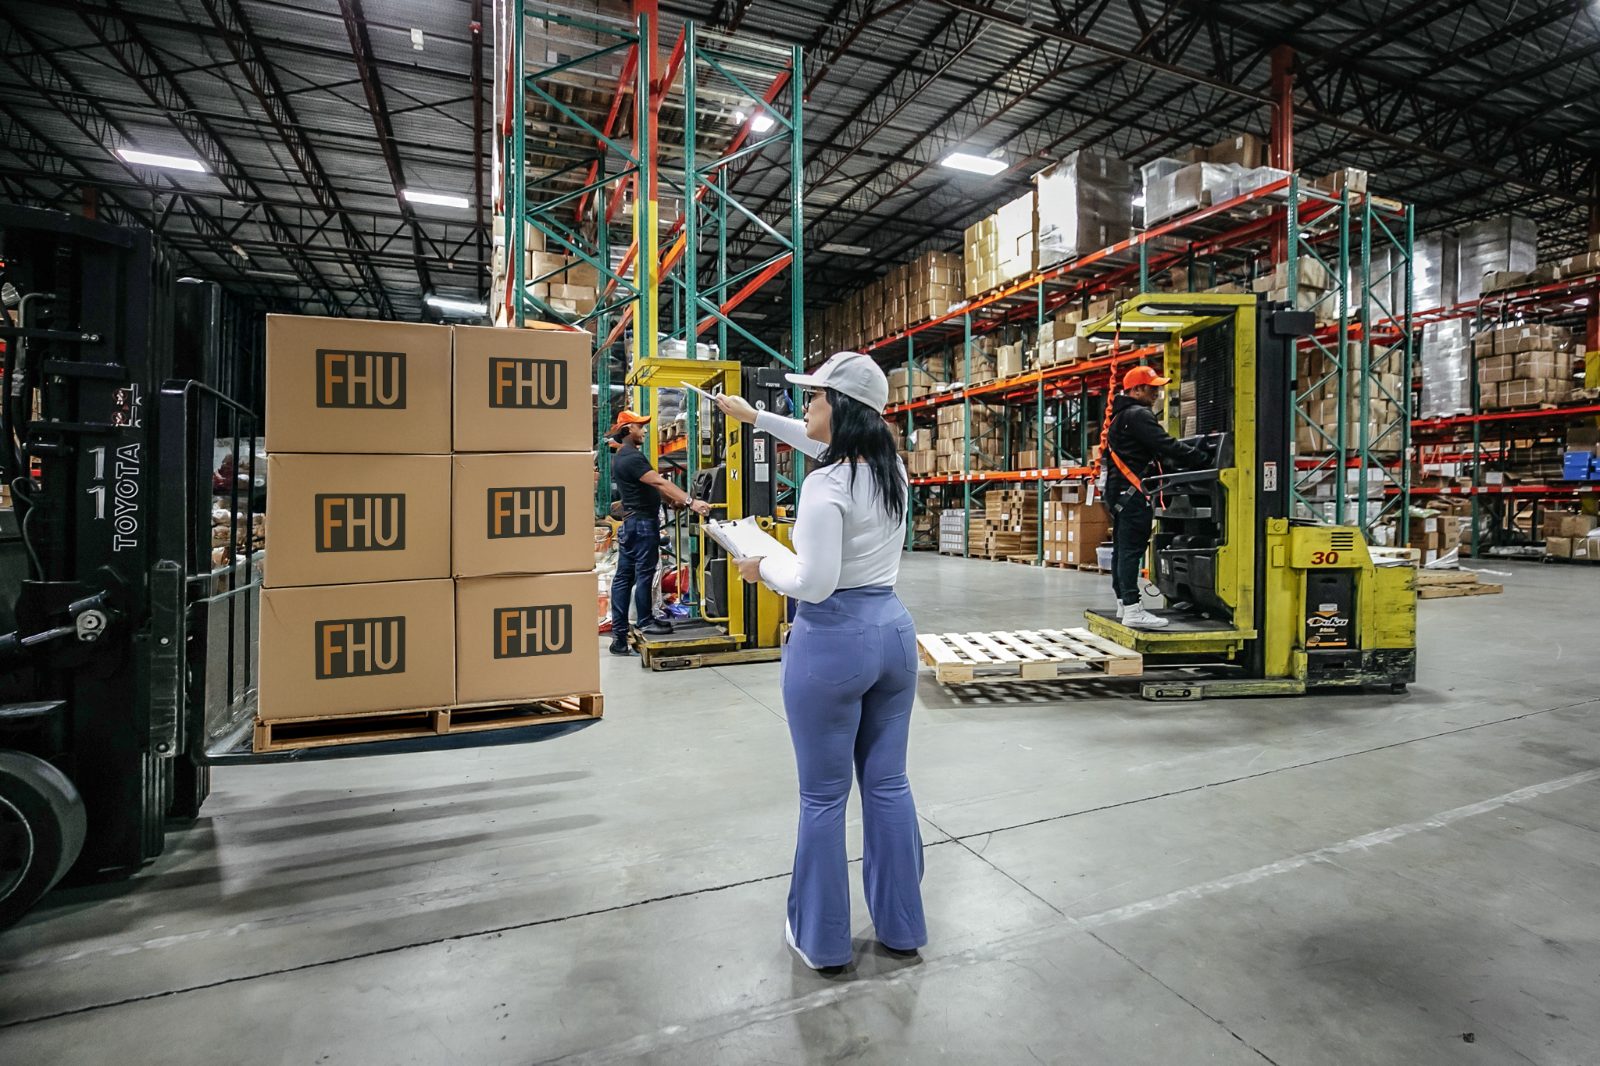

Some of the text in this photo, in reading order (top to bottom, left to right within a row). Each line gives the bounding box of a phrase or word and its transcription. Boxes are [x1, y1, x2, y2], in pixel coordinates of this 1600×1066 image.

[324, 352, 399, 405] FHU
[496, 361, 561, 406] FHU
[113, 442, 141, 552] TOYOTA
[495, 489, 559, 535] FHU
[323, 498, 399, 549] FHU
[1311, 551, 1339, 565] 30
[323, 620, 399, 675] FHU
[501, 607, 566, 655] FHU
